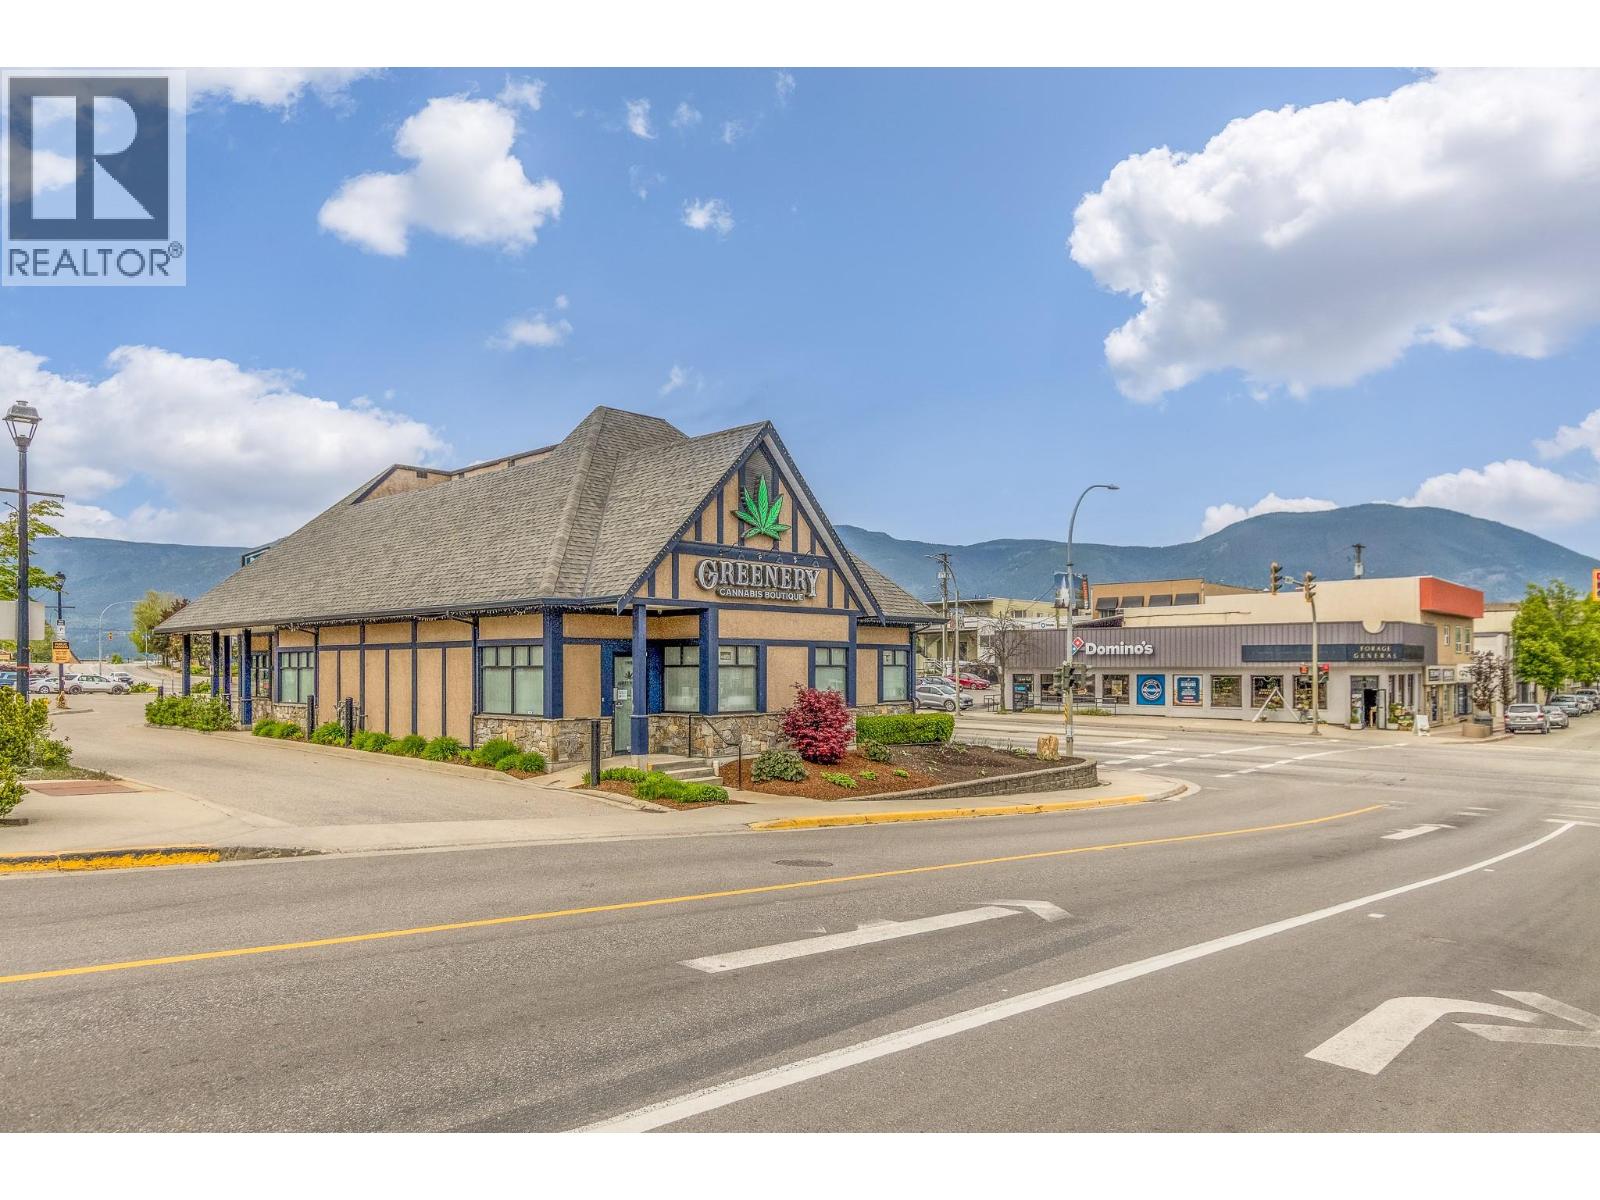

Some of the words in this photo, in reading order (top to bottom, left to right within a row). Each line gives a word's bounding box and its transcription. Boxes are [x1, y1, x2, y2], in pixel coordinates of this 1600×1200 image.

[696, 559, 821, 598] GREENERY
[719, 588, 763, 599] CANNABIS
[764, 591, 805, 601] BOUTIQUE
[1084, 640, 1154, 656] Domino's
